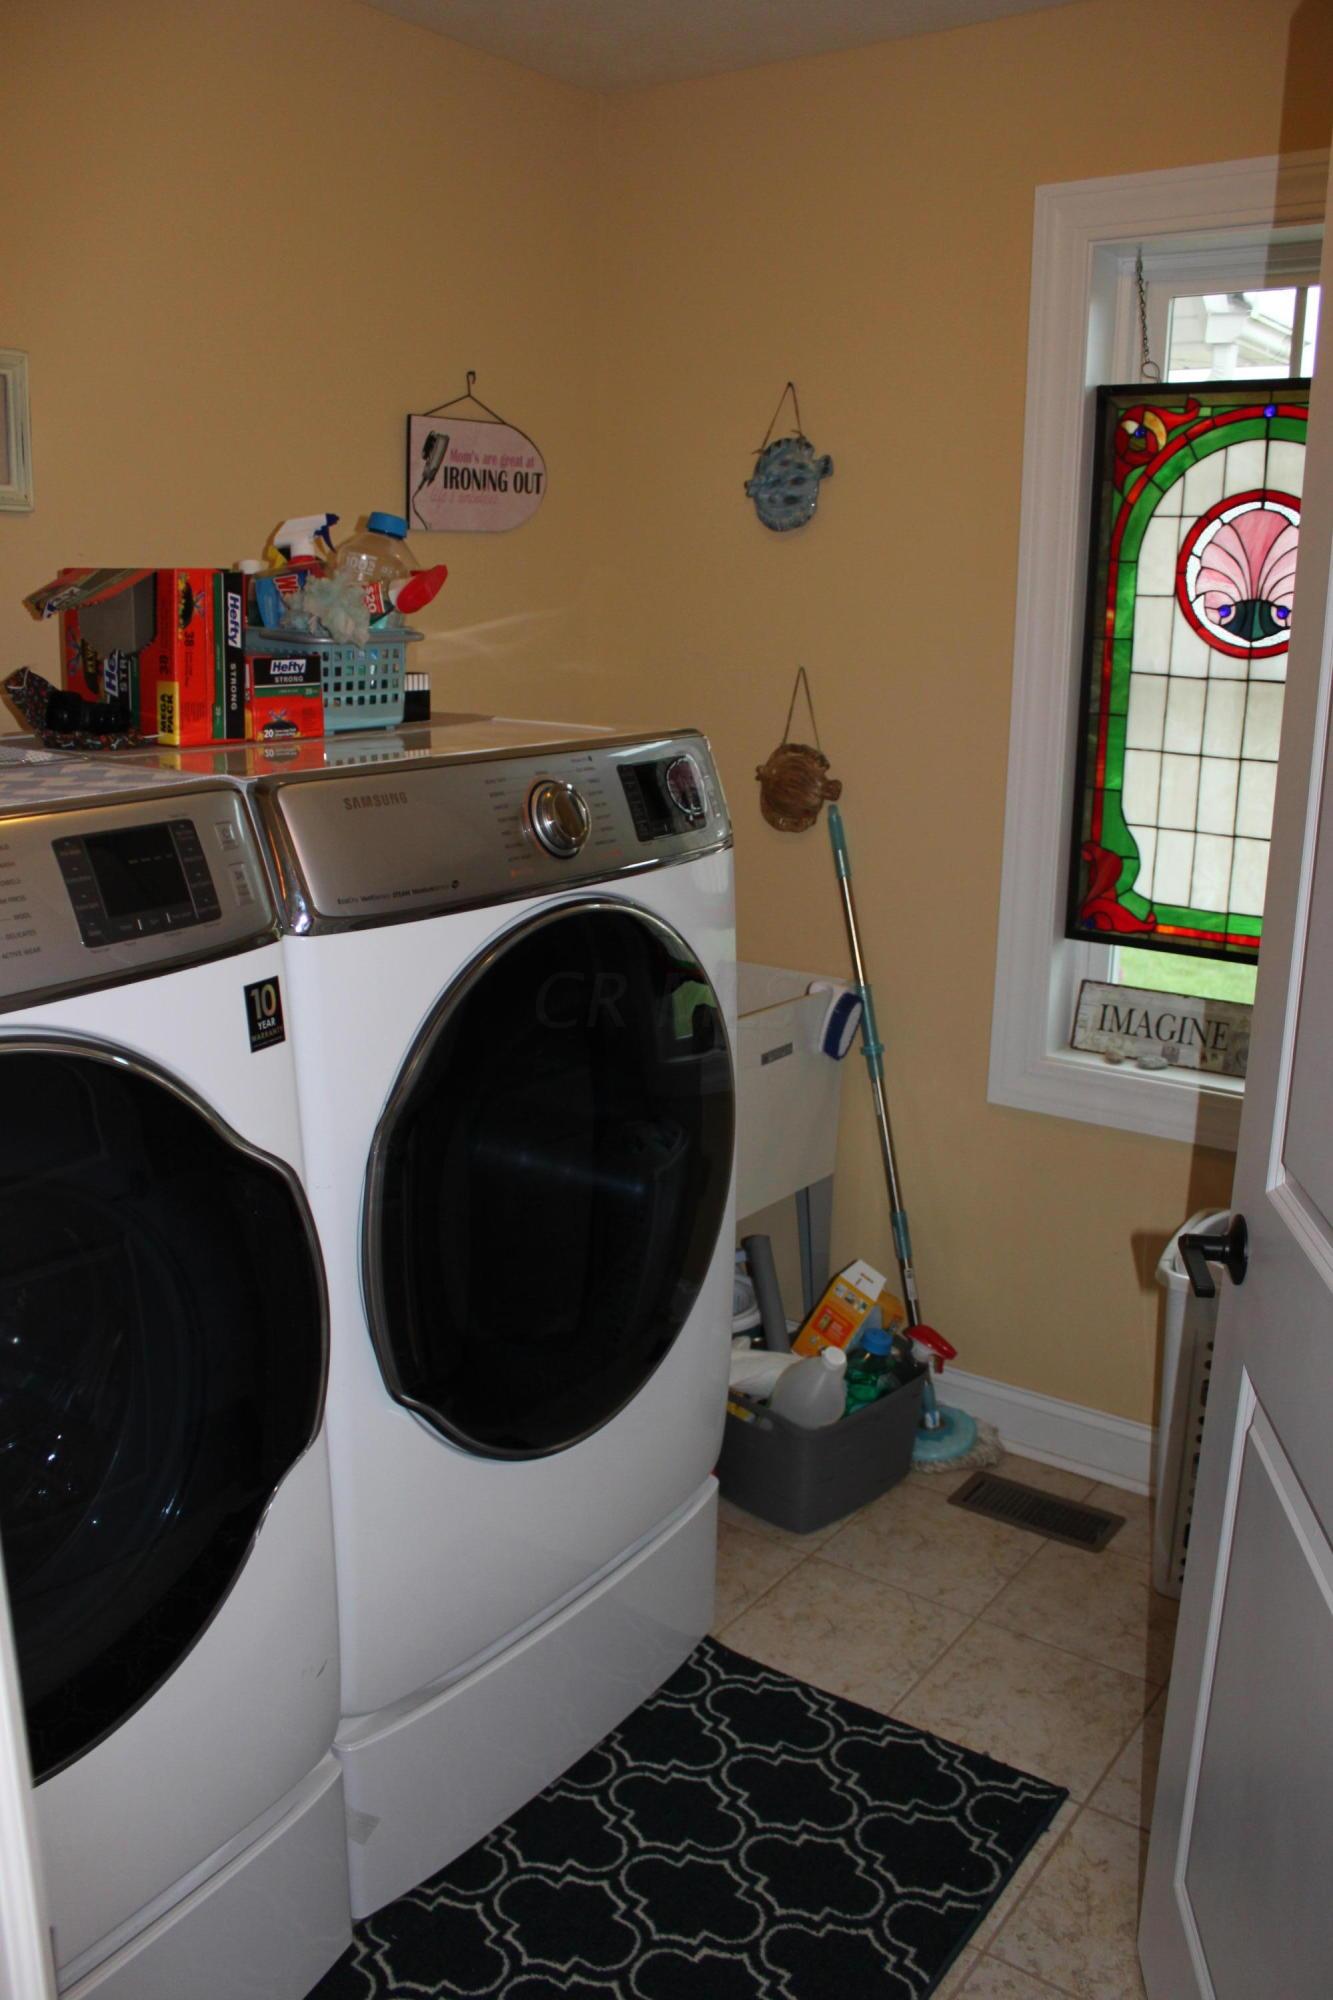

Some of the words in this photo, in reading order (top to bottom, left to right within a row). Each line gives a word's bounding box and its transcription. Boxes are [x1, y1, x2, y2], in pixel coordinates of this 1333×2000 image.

[443, 466, 508, 493] IRONING
[513, 471, 543, 494] OUT
[229, 594, 241, 648] Hefty
[272, 661, 305, 674] Hefty
[274, 675, 304, 684] STRONG
[229, 663, 239, 710] STRONG
[160, 693, 168, 733] MEGA
[264, 729, 274, 739] 20
[343, 791, 408, 811] SAMSUNG
[251, 984, 276, 1019] 10
[257, 1018, 276, 1031] YEAR
[1098, 1003, 1230, 1052] IMAGINE
